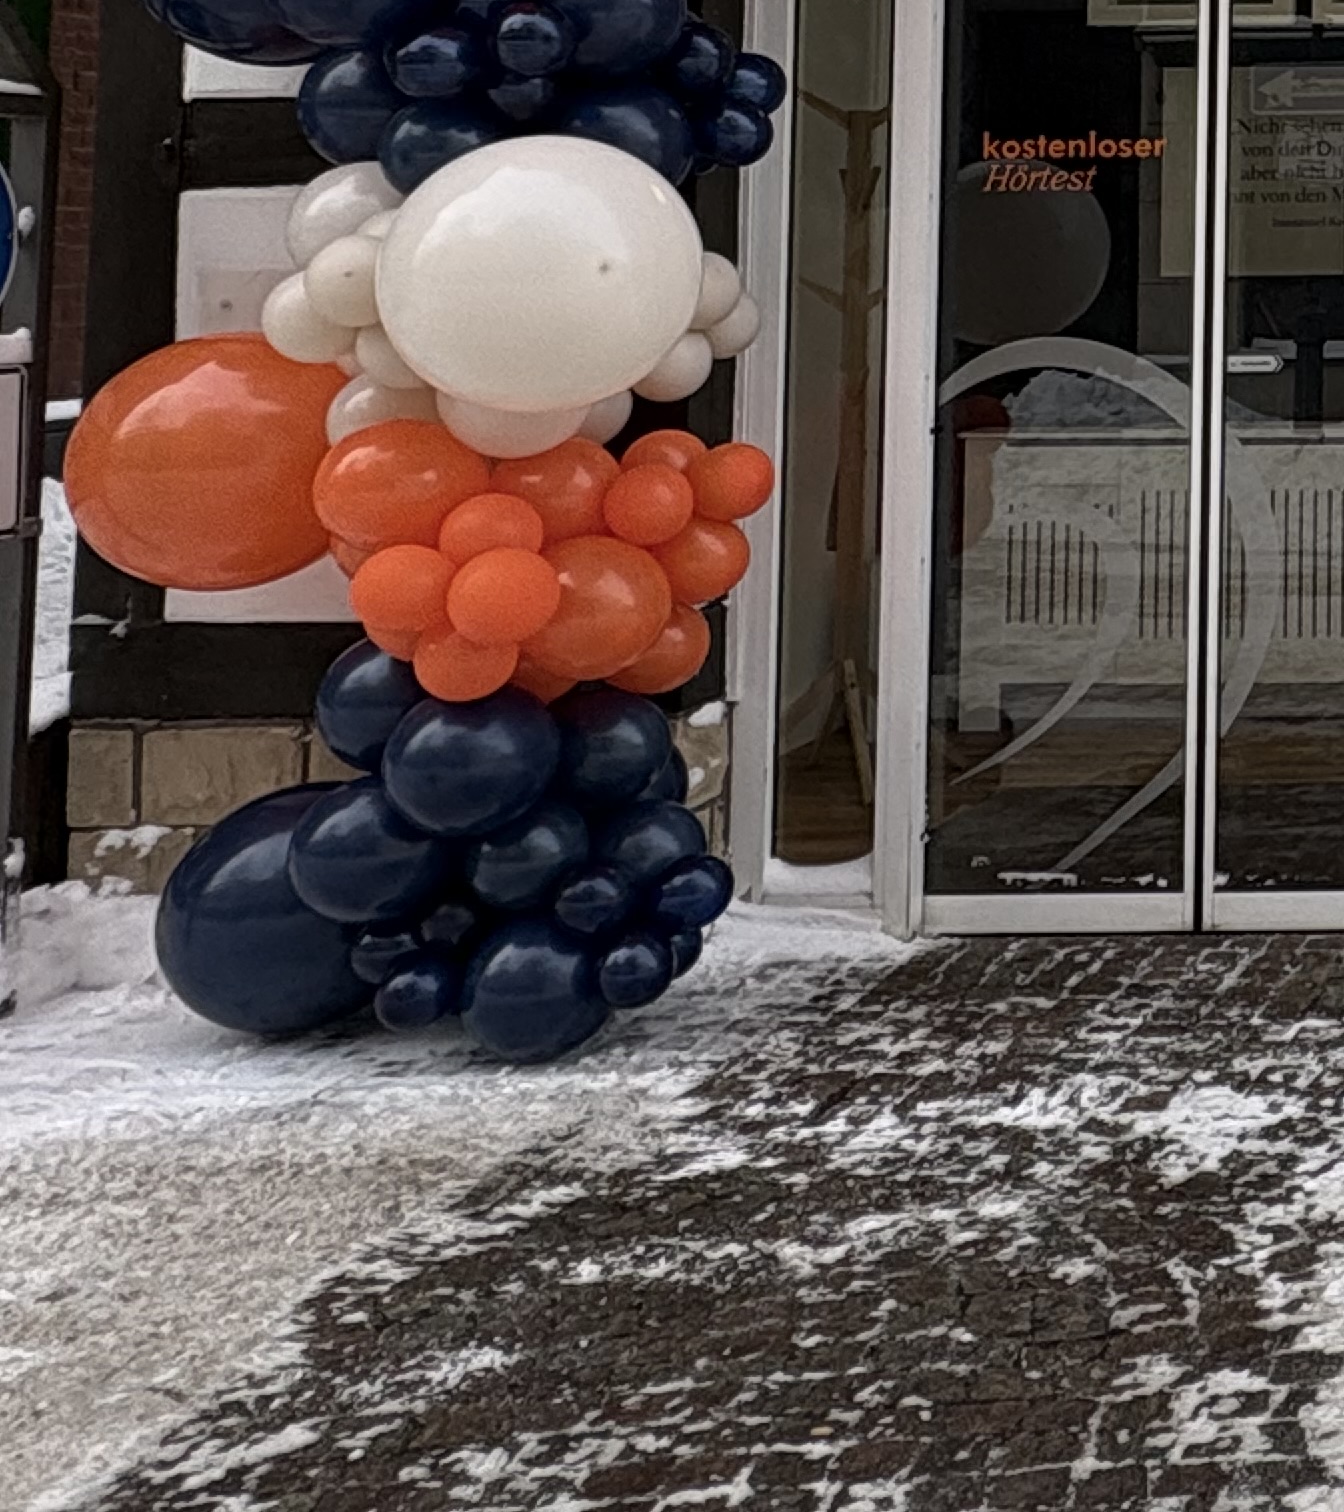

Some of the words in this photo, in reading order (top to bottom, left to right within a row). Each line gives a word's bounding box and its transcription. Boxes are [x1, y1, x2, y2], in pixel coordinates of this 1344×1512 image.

[982, 130, 1168, 161] kostenloser
[983, 164, 1098, 192] Hörtest
[1294, 188, 1326, 203] den
